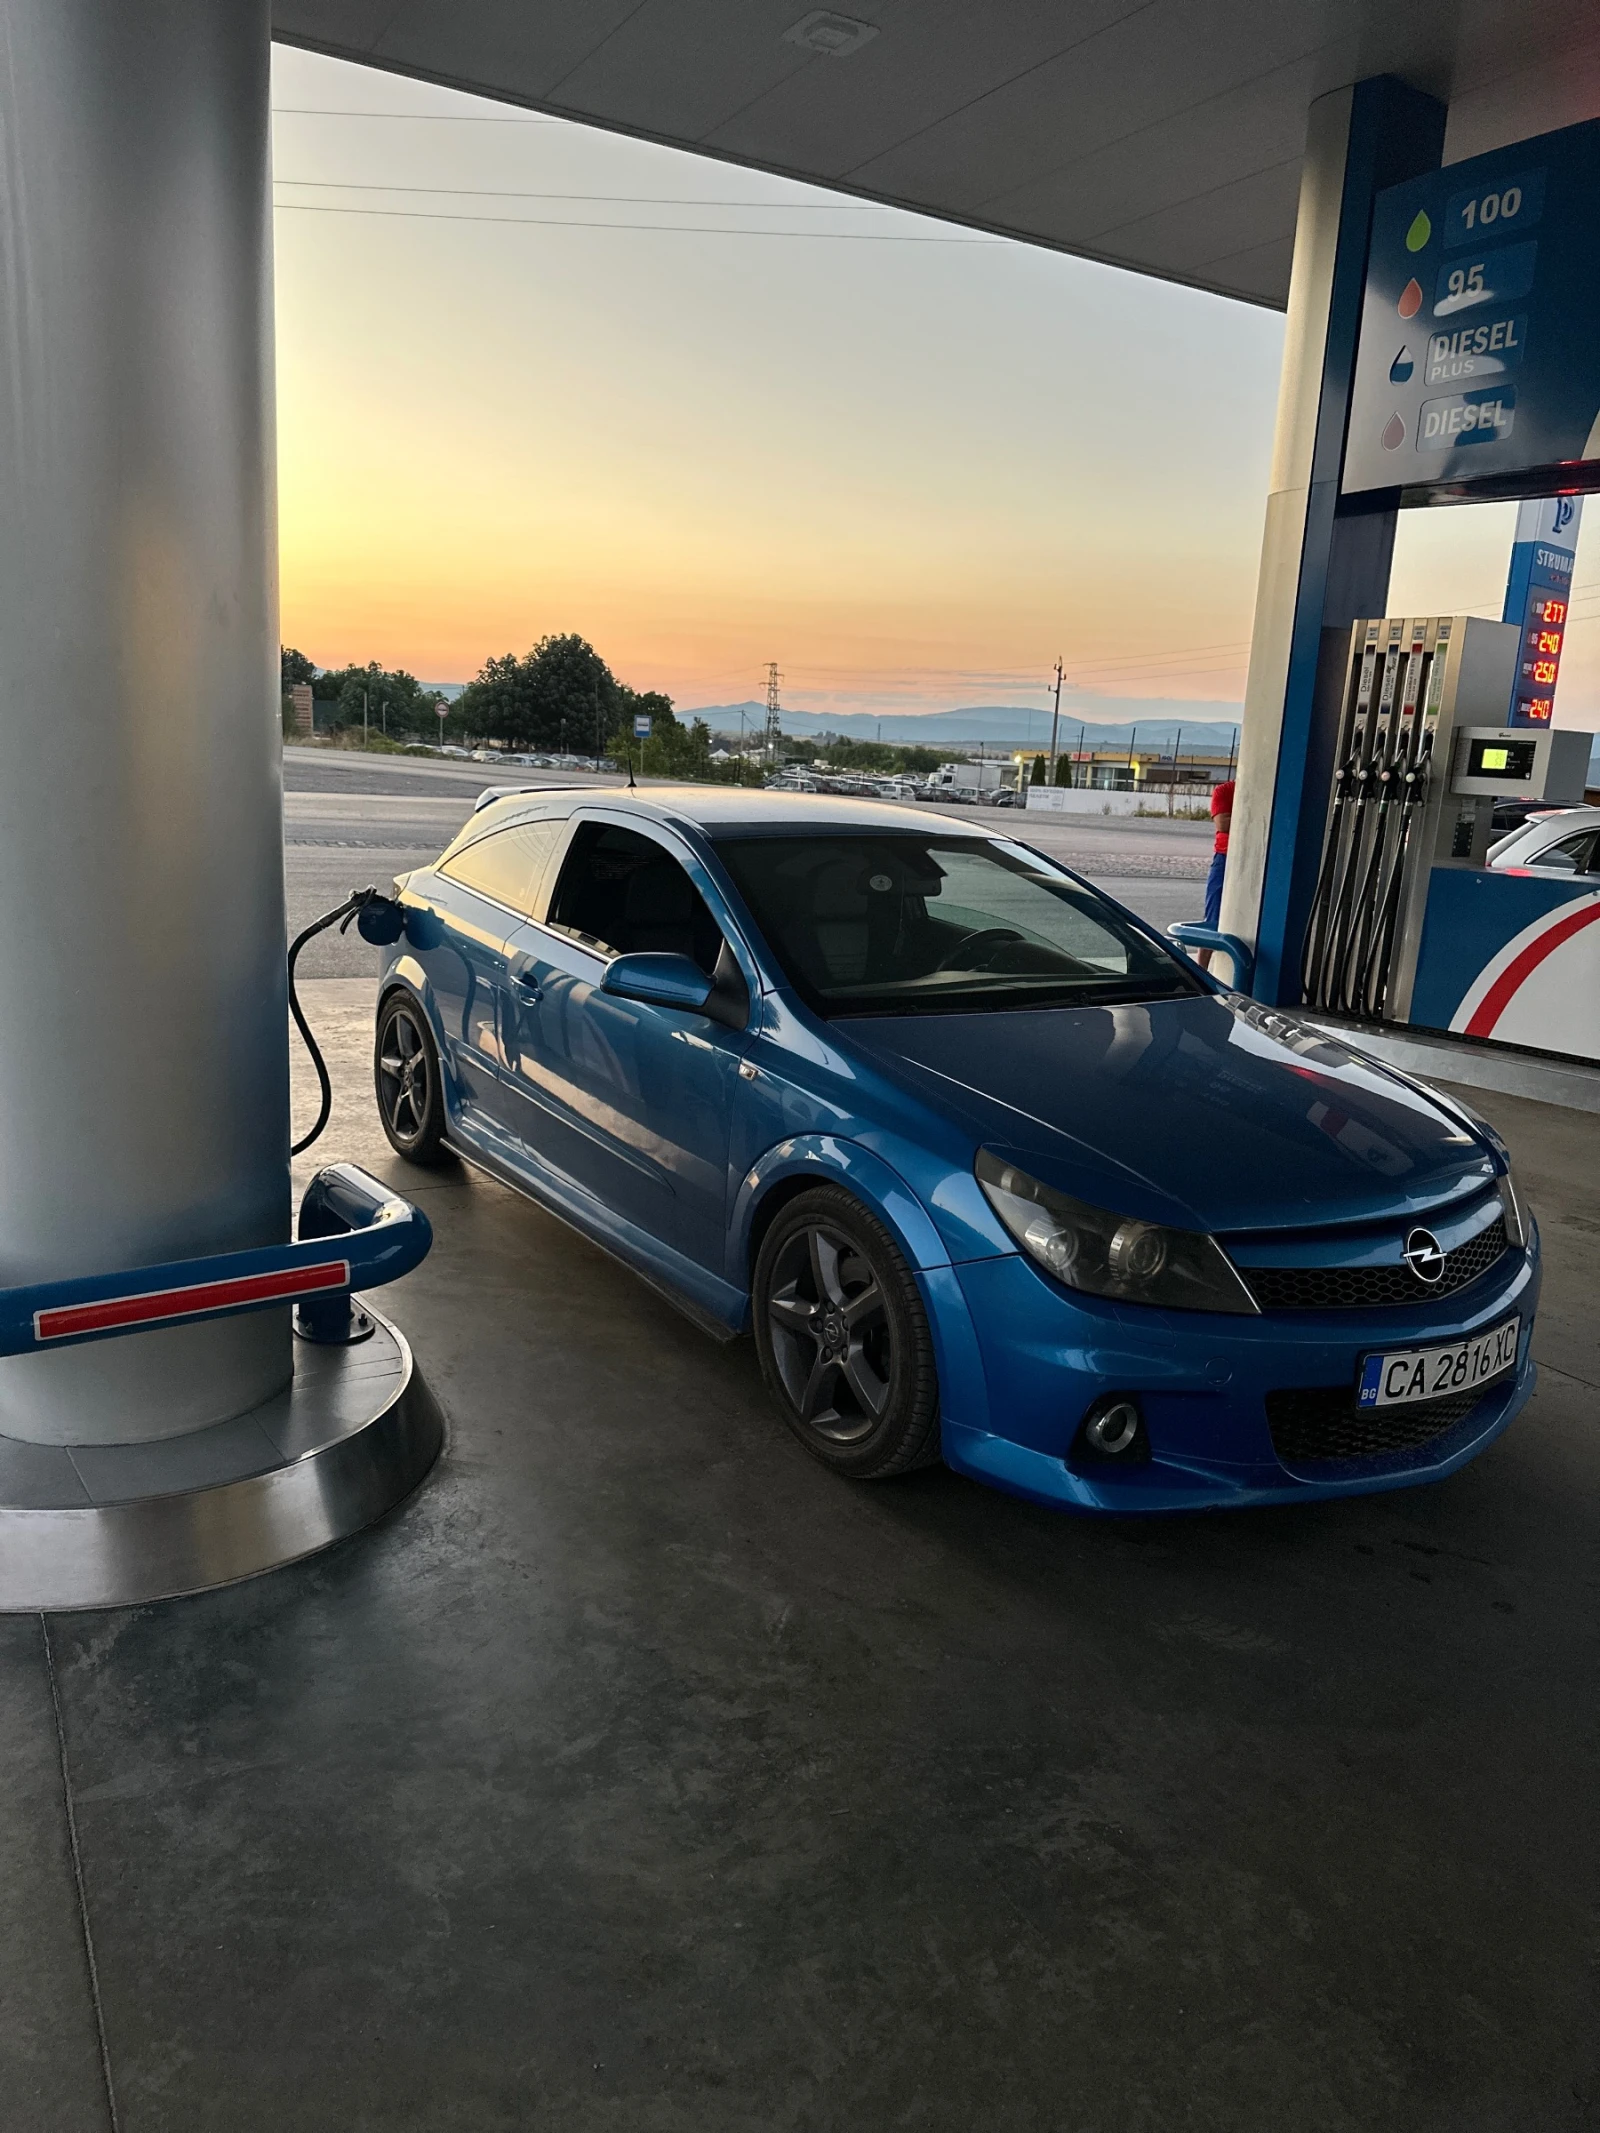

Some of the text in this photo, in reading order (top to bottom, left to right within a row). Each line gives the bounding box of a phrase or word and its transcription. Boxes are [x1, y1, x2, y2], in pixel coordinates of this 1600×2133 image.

[1462, 187, 1522, 229] 100
[1448, 263, 1485, 302] 95
[1433, 320, 1518, 363] DIESEL
[1431, 359, 1475, 381] PLUS
[1424, 400, 1507, 438] DIESEL
[1543, 601, 1564, 623] 277
[1538, 632, 1560, 655] 240
[1360, 666, 1370, 692] Diesel
[1534, 662, 1556, 684] 250
[1382, 675, 1392, 701] Diesel
[1529, 699, 1550, 720] 240
[1385, 1324, 1515, 1398] CA 2816 XC
[1361, 1388, 1376, 1400] BG
